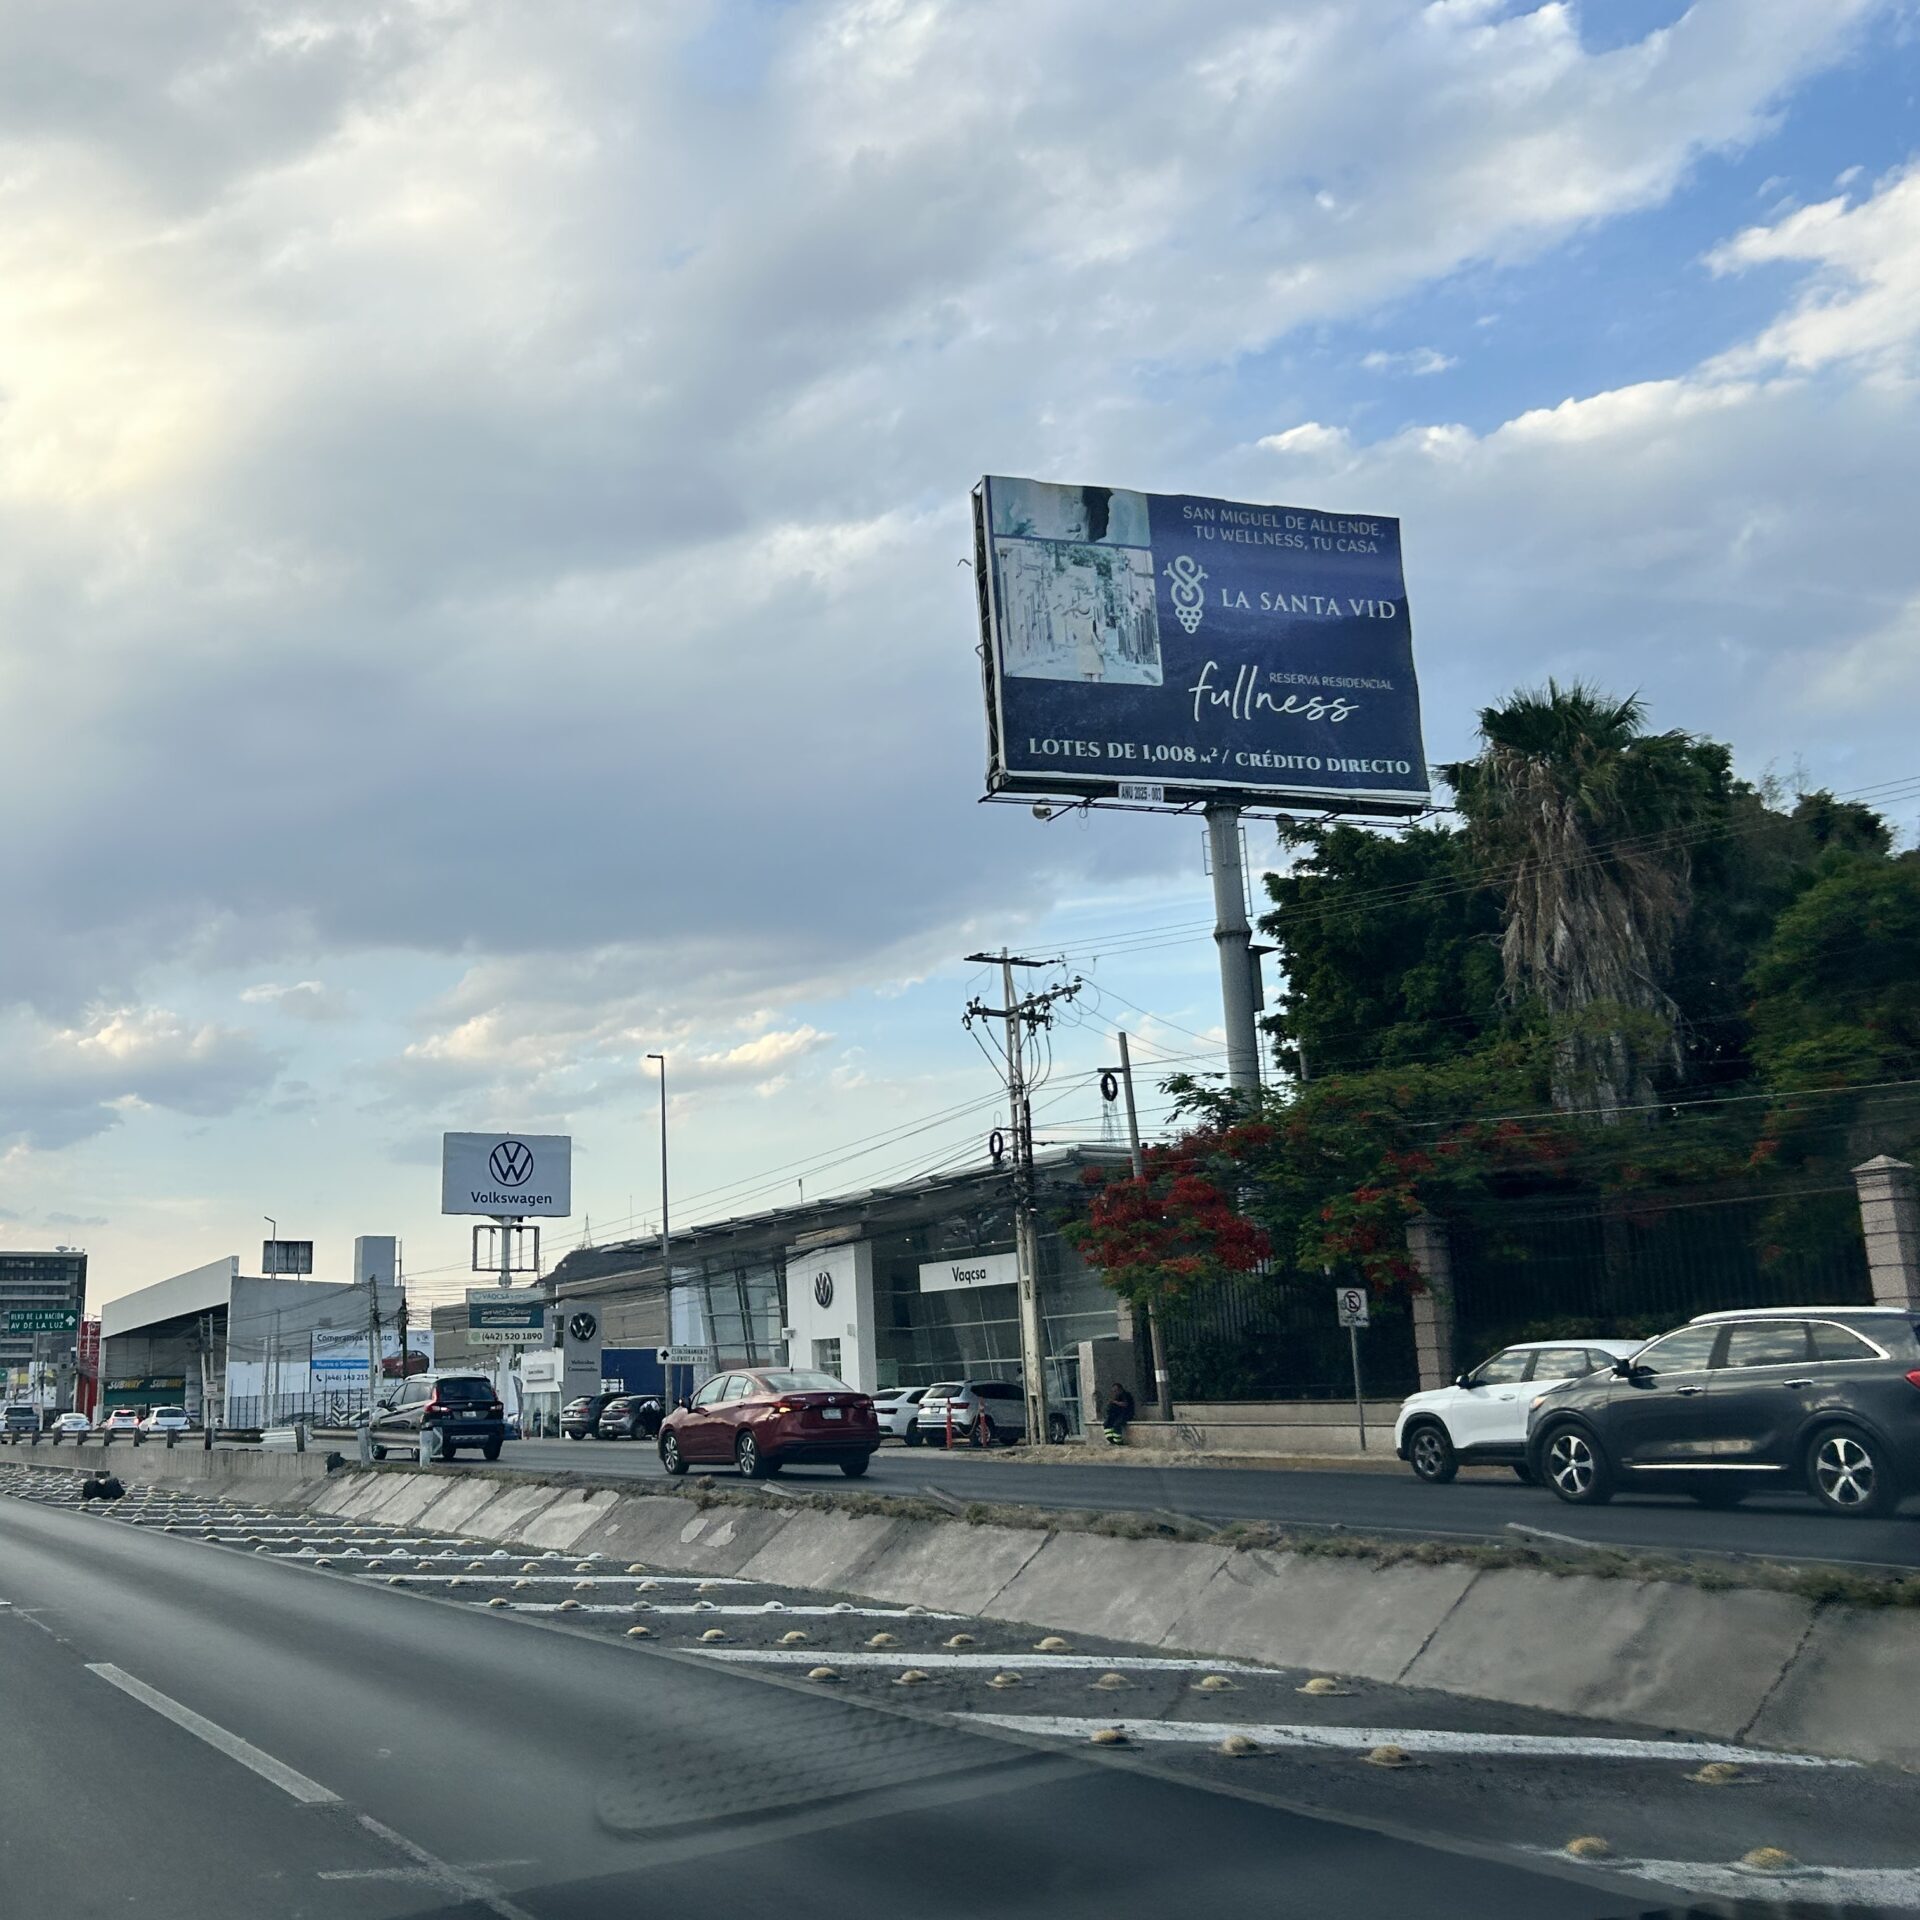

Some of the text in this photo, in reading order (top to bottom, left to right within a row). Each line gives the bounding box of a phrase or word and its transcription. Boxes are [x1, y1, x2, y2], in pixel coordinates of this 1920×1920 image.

[1183, 506, 1385, 537] SAN MIGUEL DE ALLENDE,
[1194, 525, 1379, 553] TU WELLNESS, TU CASA
[1221, 588, 1396, 619] LA SANTA VID
[1269, 672, 1395, 690] RESERVA RESIDENCIAL
[1188, 660, 1360, 722] fullness
[1029, 738, 1101, 758] LOTES
[1107, 742, 1137, 759] DE
[1142, 744, 1197, 763] 1,008
[1235, 749, 1321, 771] CRÉDITO
[1326, 757, 1411, 775] DIRECTO
[471, 1191, 552, 1207] Volkswagen
[952, 1266, 987, 1284] Vaqcsa
[482, 1332, 542, 1341] (442) 520 1890
[108, 1379, 144, 1390] SUBWAY
[149, 1379, 184, 1389] SUBWAY
